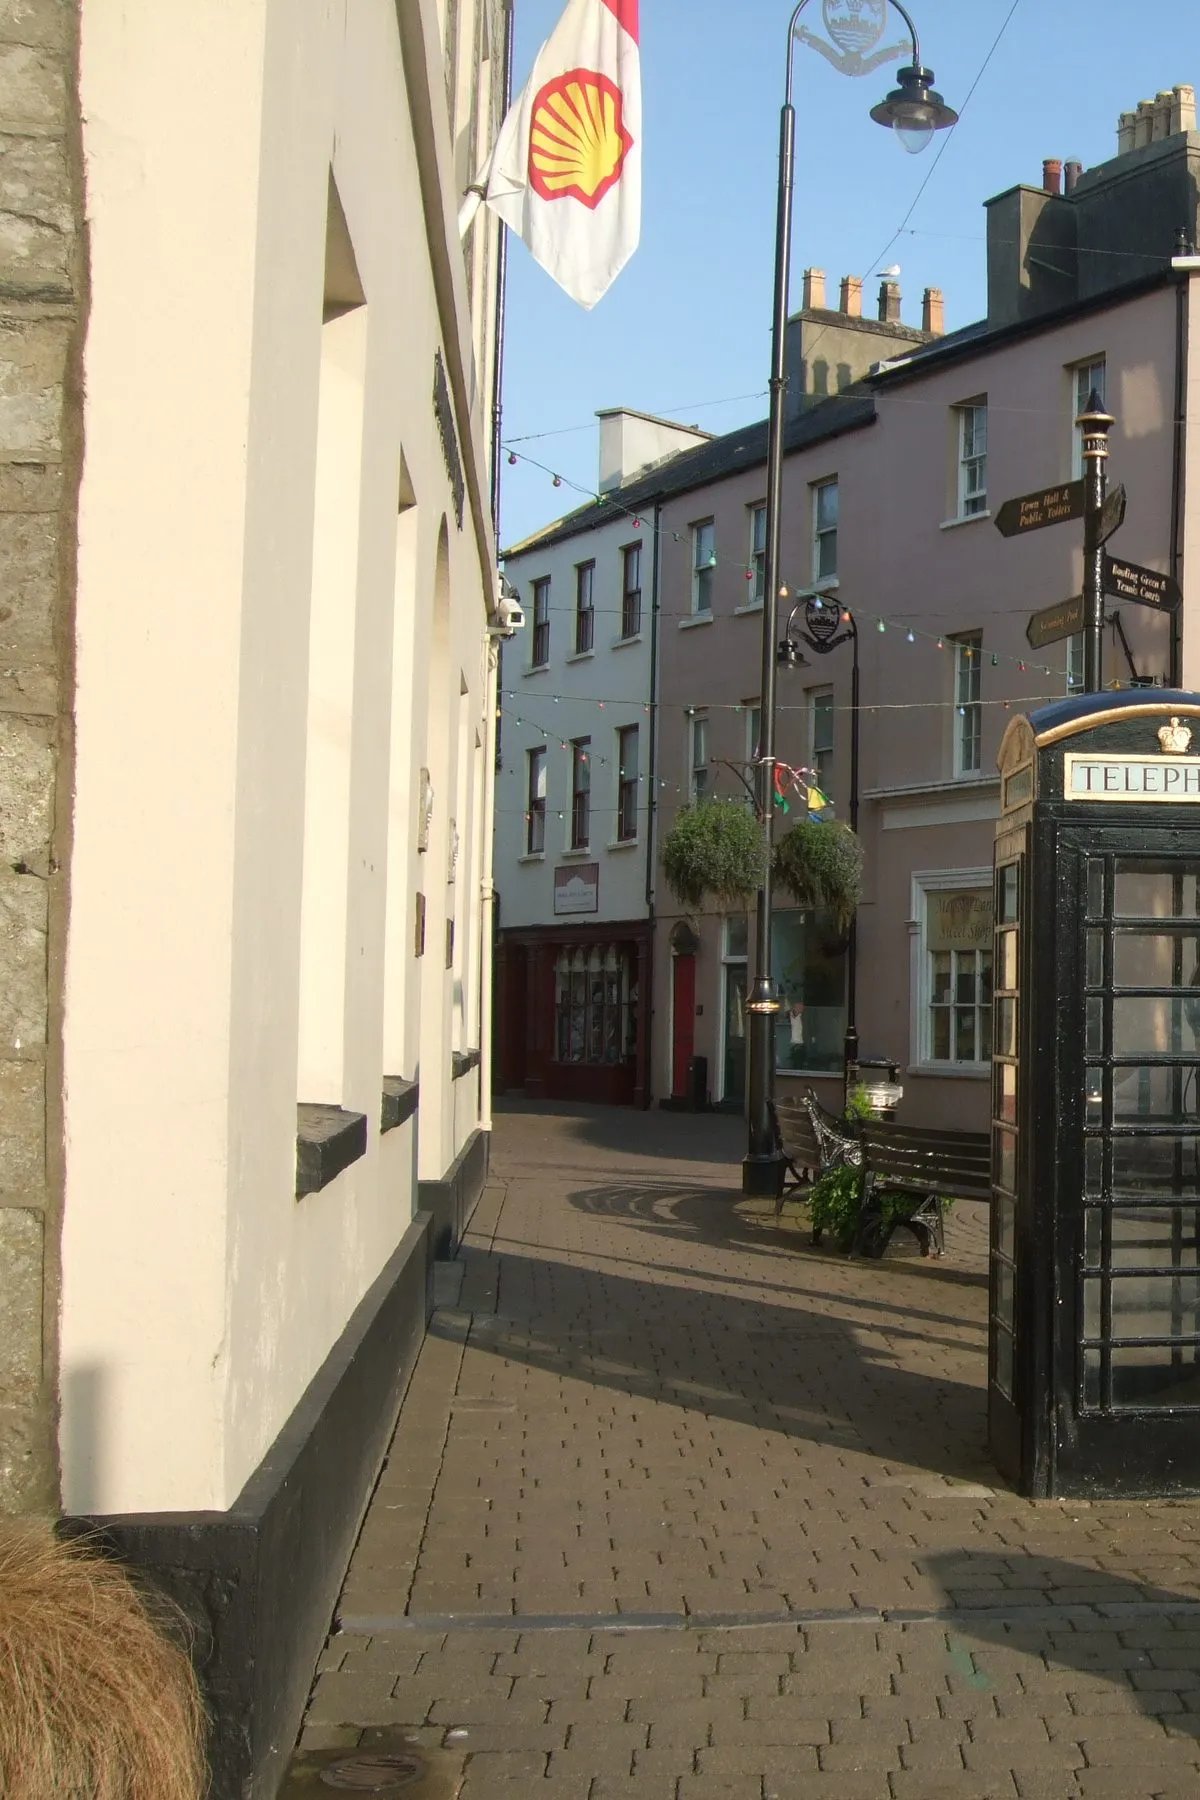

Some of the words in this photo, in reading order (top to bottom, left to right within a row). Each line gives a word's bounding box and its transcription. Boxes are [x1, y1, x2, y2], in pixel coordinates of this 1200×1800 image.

[1020, 500, 1040, 513] Town
[1043, 491, 1060, 506] Hall
[1062, 488, 1070, 500] &
[1019, 511, 1043, 527] Public
[1047, 504, 1072, 518] Toilets
[1112, 563, 1139, 584] Bowling
[1140, 573, 1160, 589] Green
[1160, 580, 1167, 591] &
[1116, 579, 1139, 595] Tennis
[1139, 586, 1161, 603] Courts
